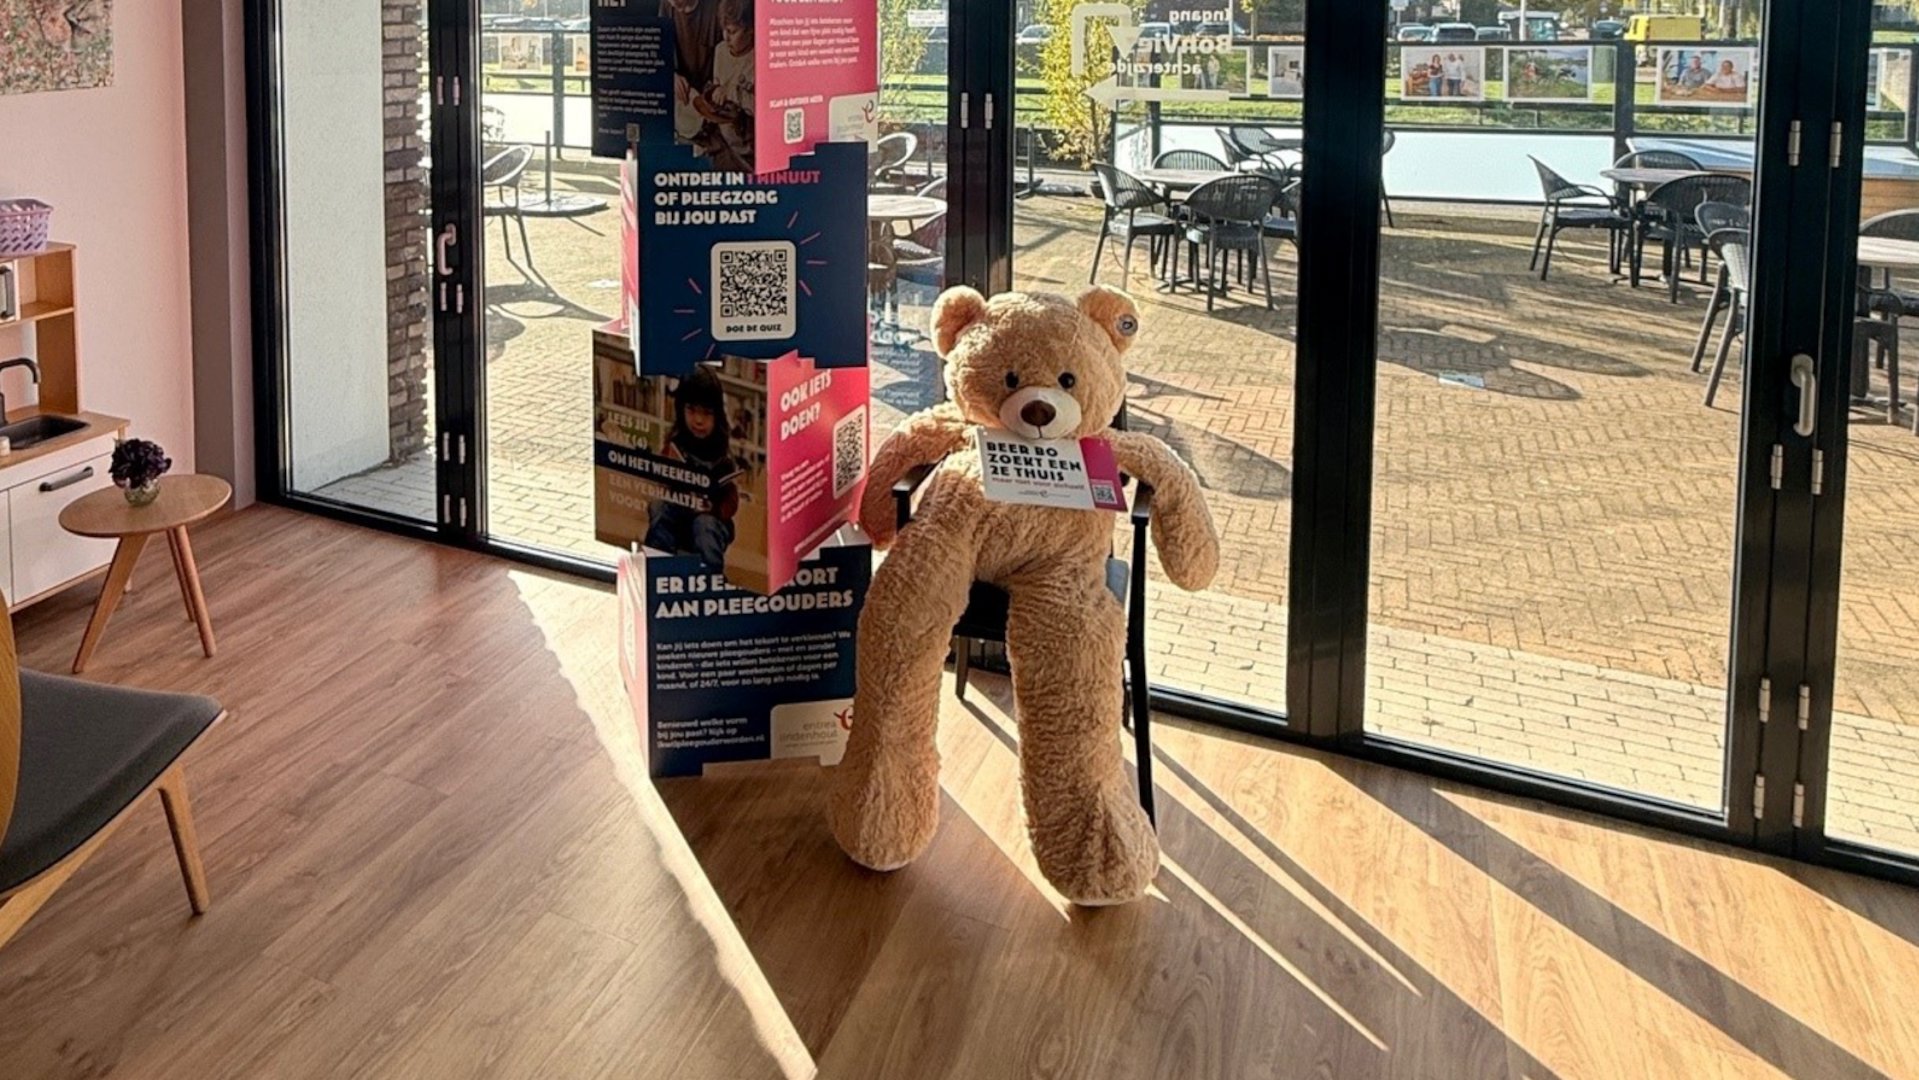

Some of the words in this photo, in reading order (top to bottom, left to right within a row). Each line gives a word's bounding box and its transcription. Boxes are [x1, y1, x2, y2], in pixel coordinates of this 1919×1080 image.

[654, 172, 724, 187] ONTDEK
[726, 172, 744, 186] IN
[756, 170, 820, 185] MINUUT
[654, 192, 678, 206] OF
[682, 190, 778, 205] PLEEGZORG
[654, 211, 679, 225] BIJ
[682, 210, 716, 224] JOU
[720, 210, 756, 224] PAST
[726, 325, 744, 333] DOE
[760, 324, 782, 332] QUIZ
[780, 382, 808, 412] OOK
[810, 368, 832, 397] IETS
[608, 411, 633, 428] LEES
[635, 416, 650, 432] JIJ
[781, 402, 821, 442] DOEN?
[987, 442, 1029, 455] BEER
[1035, 446, 1058, 457] BO
[608, 450, 626, 466] OM
[628, 454, 650, 472] HET
[652, 459, 710, 488] WEEKEND
[987, 454, 1042, 468] ZOEKT
[1048, 460, 1082, 471] EEN
[990, 466, 1010, 476] 2E
[1014, 467, 1064, 481] THUIS
[609, 474, 630, 489] EEN
[633, 480, 706, 511] VERHAALTJE
[656, 576, 684, 594] ER
[688, 575, 706, 592] IS
[655, 600, 699, 619] AAN
[704, 590, 854, 616] PLEEGOUDERS
[656, 643, 672, 651] Kan
[684, 642, 699, 650] iets
[701, 641, 722, 649] doen
[739, 639, 753, 647] het
[754, 638, 779, 646] tekort
[656, 652, 686, 660] zoeken
[688, 651, 718, 659] nieuwe
[720, 649, 771, 659] pleegouders
[778, 645, 794, 653] met
[656, 662, 694, 670] kinderen
[701, 659, 714, 668] die
[716, 660, 731, 668] iets
[732, 658, 757, 666] willen
[759, 655, 802, 664] betekenen
[718, 669, 736, 678] paar
[738, 665, 785, 675] weekenden
[796, 662, 822, 672] dagen
[823, 661, 837, 670] per
[753, 677, 771, 685] lang
[786, 674, 810, 682] nodig
